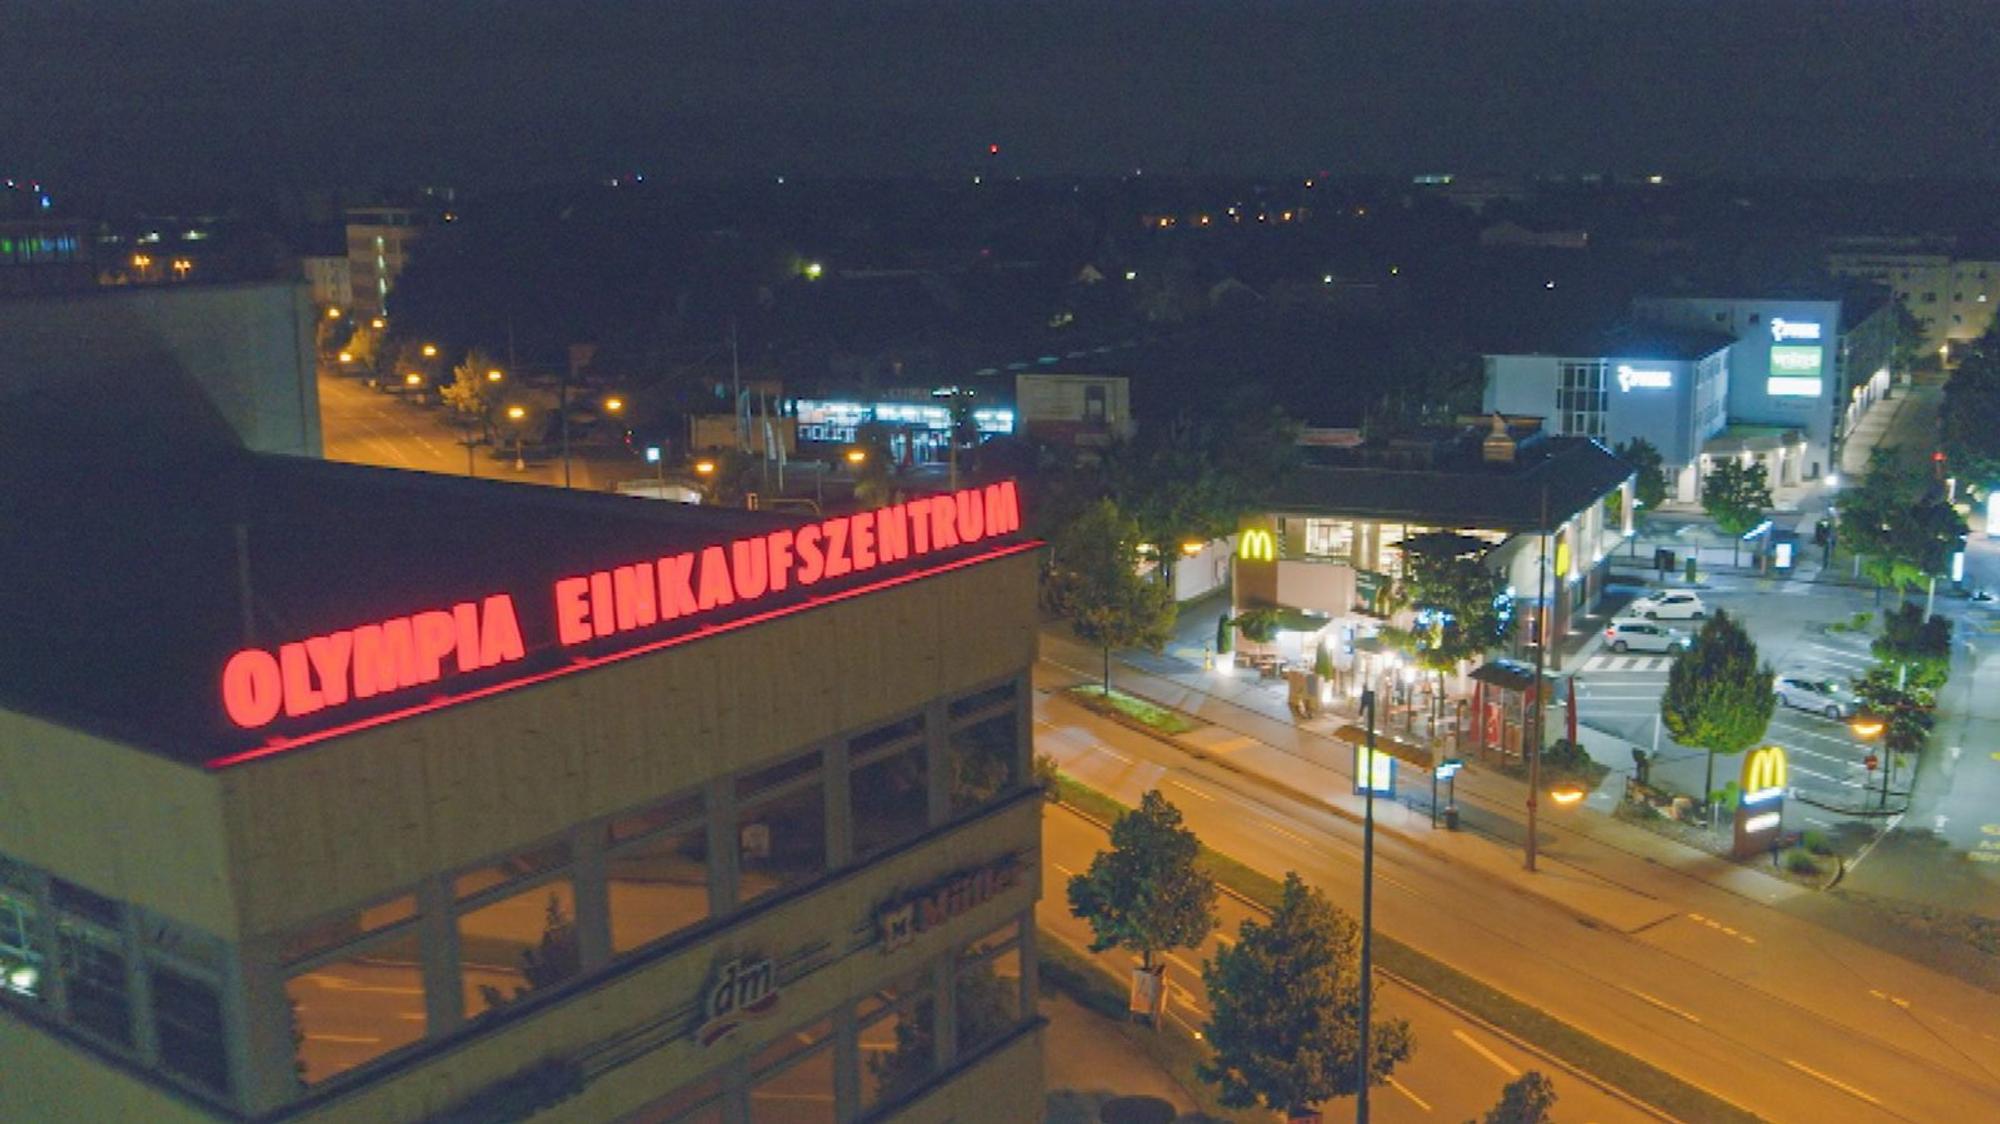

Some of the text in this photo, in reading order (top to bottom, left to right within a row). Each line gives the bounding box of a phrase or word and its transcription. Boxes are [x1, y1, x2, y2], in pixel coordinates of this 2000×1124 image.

[222, 480, 1022, 729] OLYMPIA EINKAUFSZENTRUM
[711, 957, 774, 1014] dm
